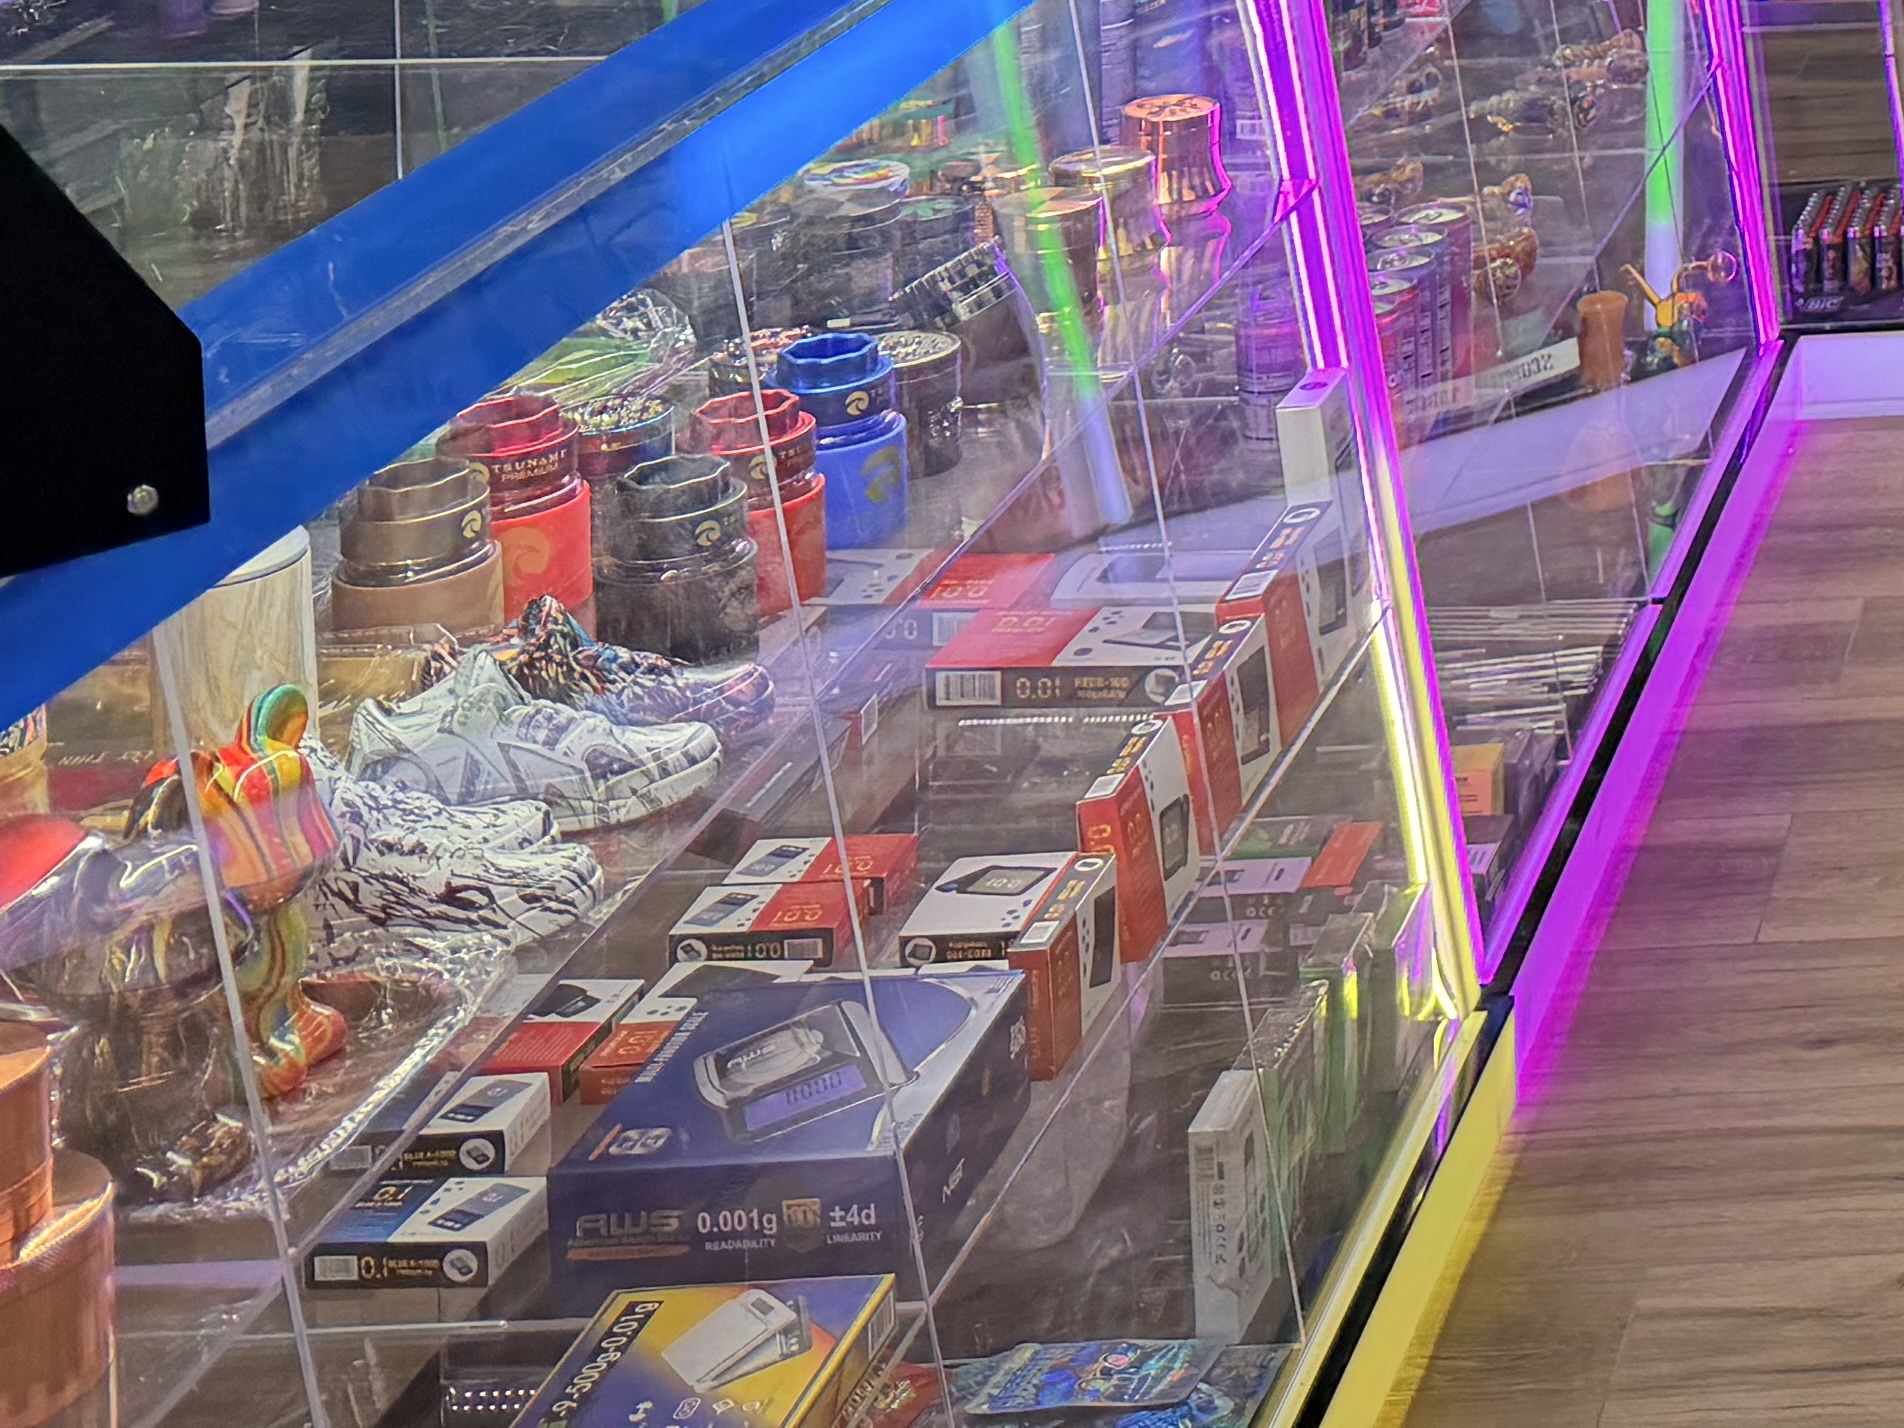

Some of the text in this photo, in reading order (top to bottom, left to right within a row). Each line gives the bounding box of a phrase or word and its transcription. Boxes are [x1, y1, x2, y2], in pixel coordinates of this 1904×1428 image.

[576, 1210, 681, 1237] AWS
[697, 1203, 877, 1236] 0.001g ±4d
[705, 1237, 776, 1251] READABILITY
[827, 1231, 882, 1244] LINEARITY
